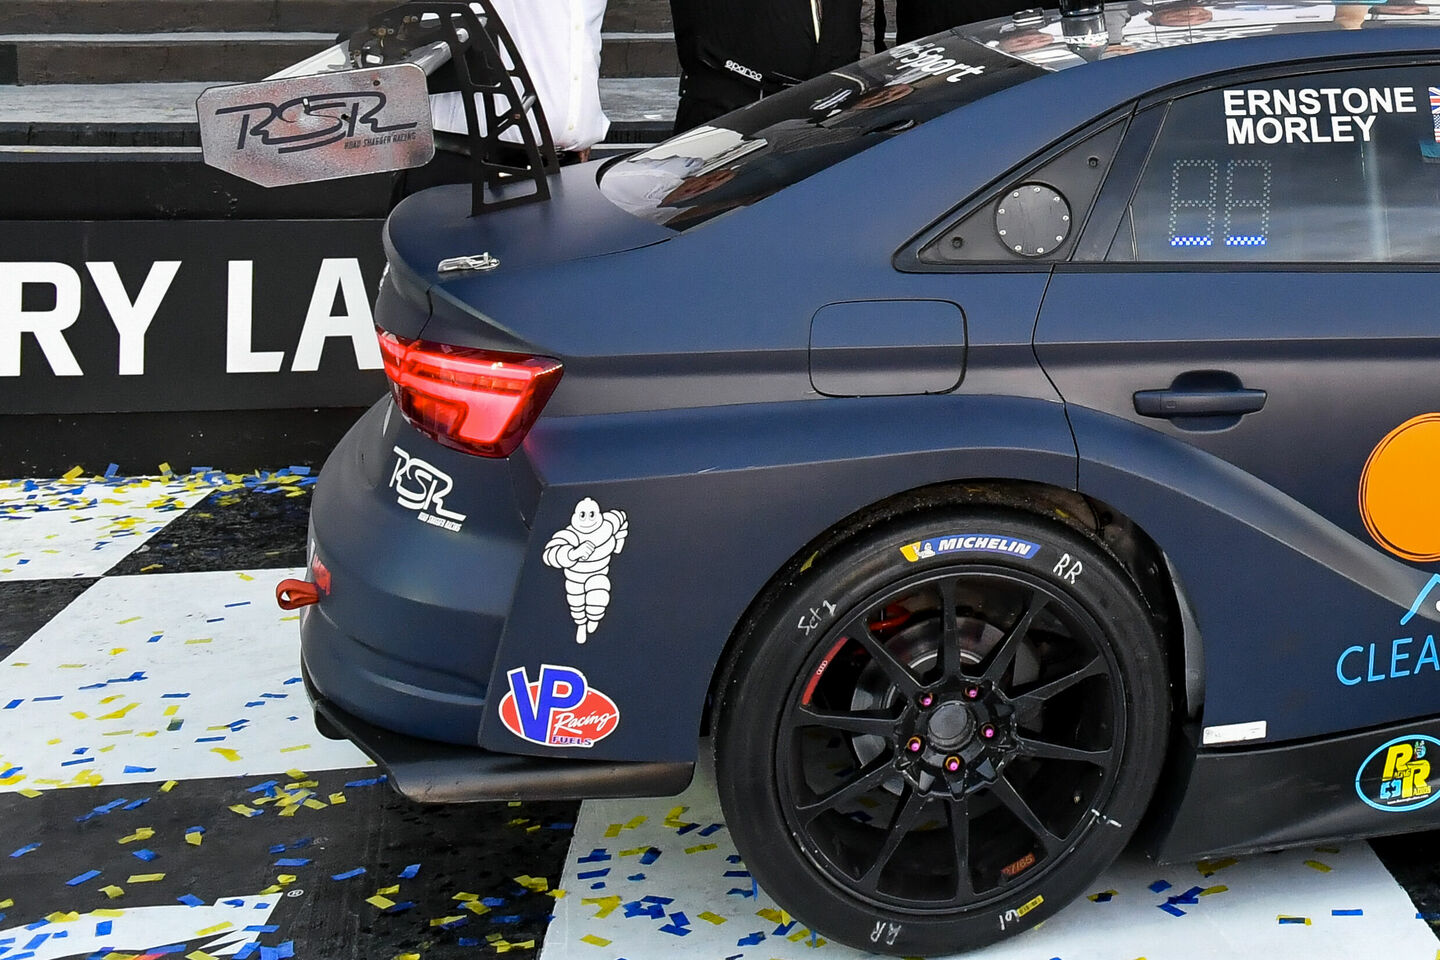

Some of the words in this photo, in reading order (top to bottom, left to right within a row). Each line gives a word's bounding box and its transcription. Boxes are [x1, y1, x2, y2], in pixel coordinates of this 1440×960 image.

[1223, 86, 1417, 116] ERNSTONE
[1226, 116, 1377, 145] MORLEY
[226, 257, 384, 374] LA
[937, 536, 1031, 556] MICHELIN
[1053, 553, 1082, 585] RR
[508, 665, 587, 745] VP
[553, 711, 618, 736] Racing
[552, 736, 593, 746] FUELS
